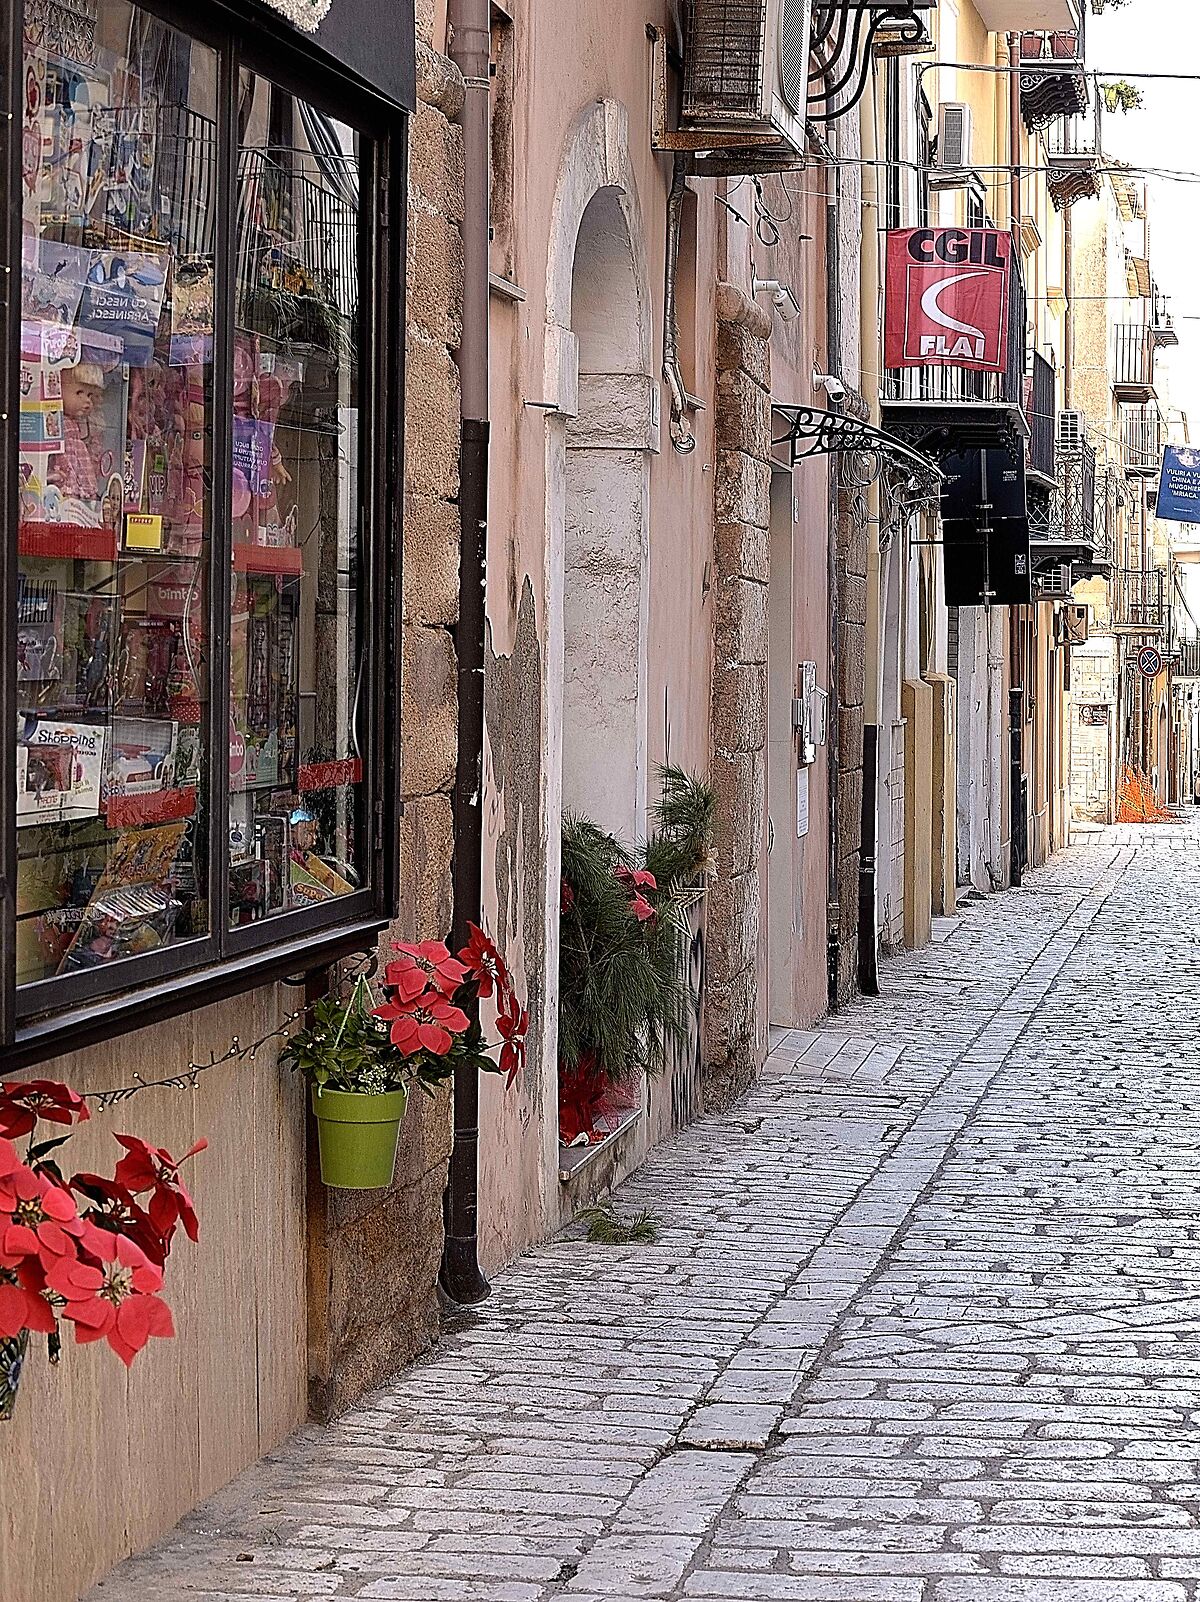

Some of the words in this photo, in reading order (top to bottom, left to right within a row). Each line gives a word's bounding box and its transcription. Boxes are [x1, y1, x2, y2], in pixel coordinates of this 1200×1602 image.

[908, 229, 1006, 268] CGIL
[920, 335, 985, 360] FLAI
[38, 729, 96, 749] Shopping
